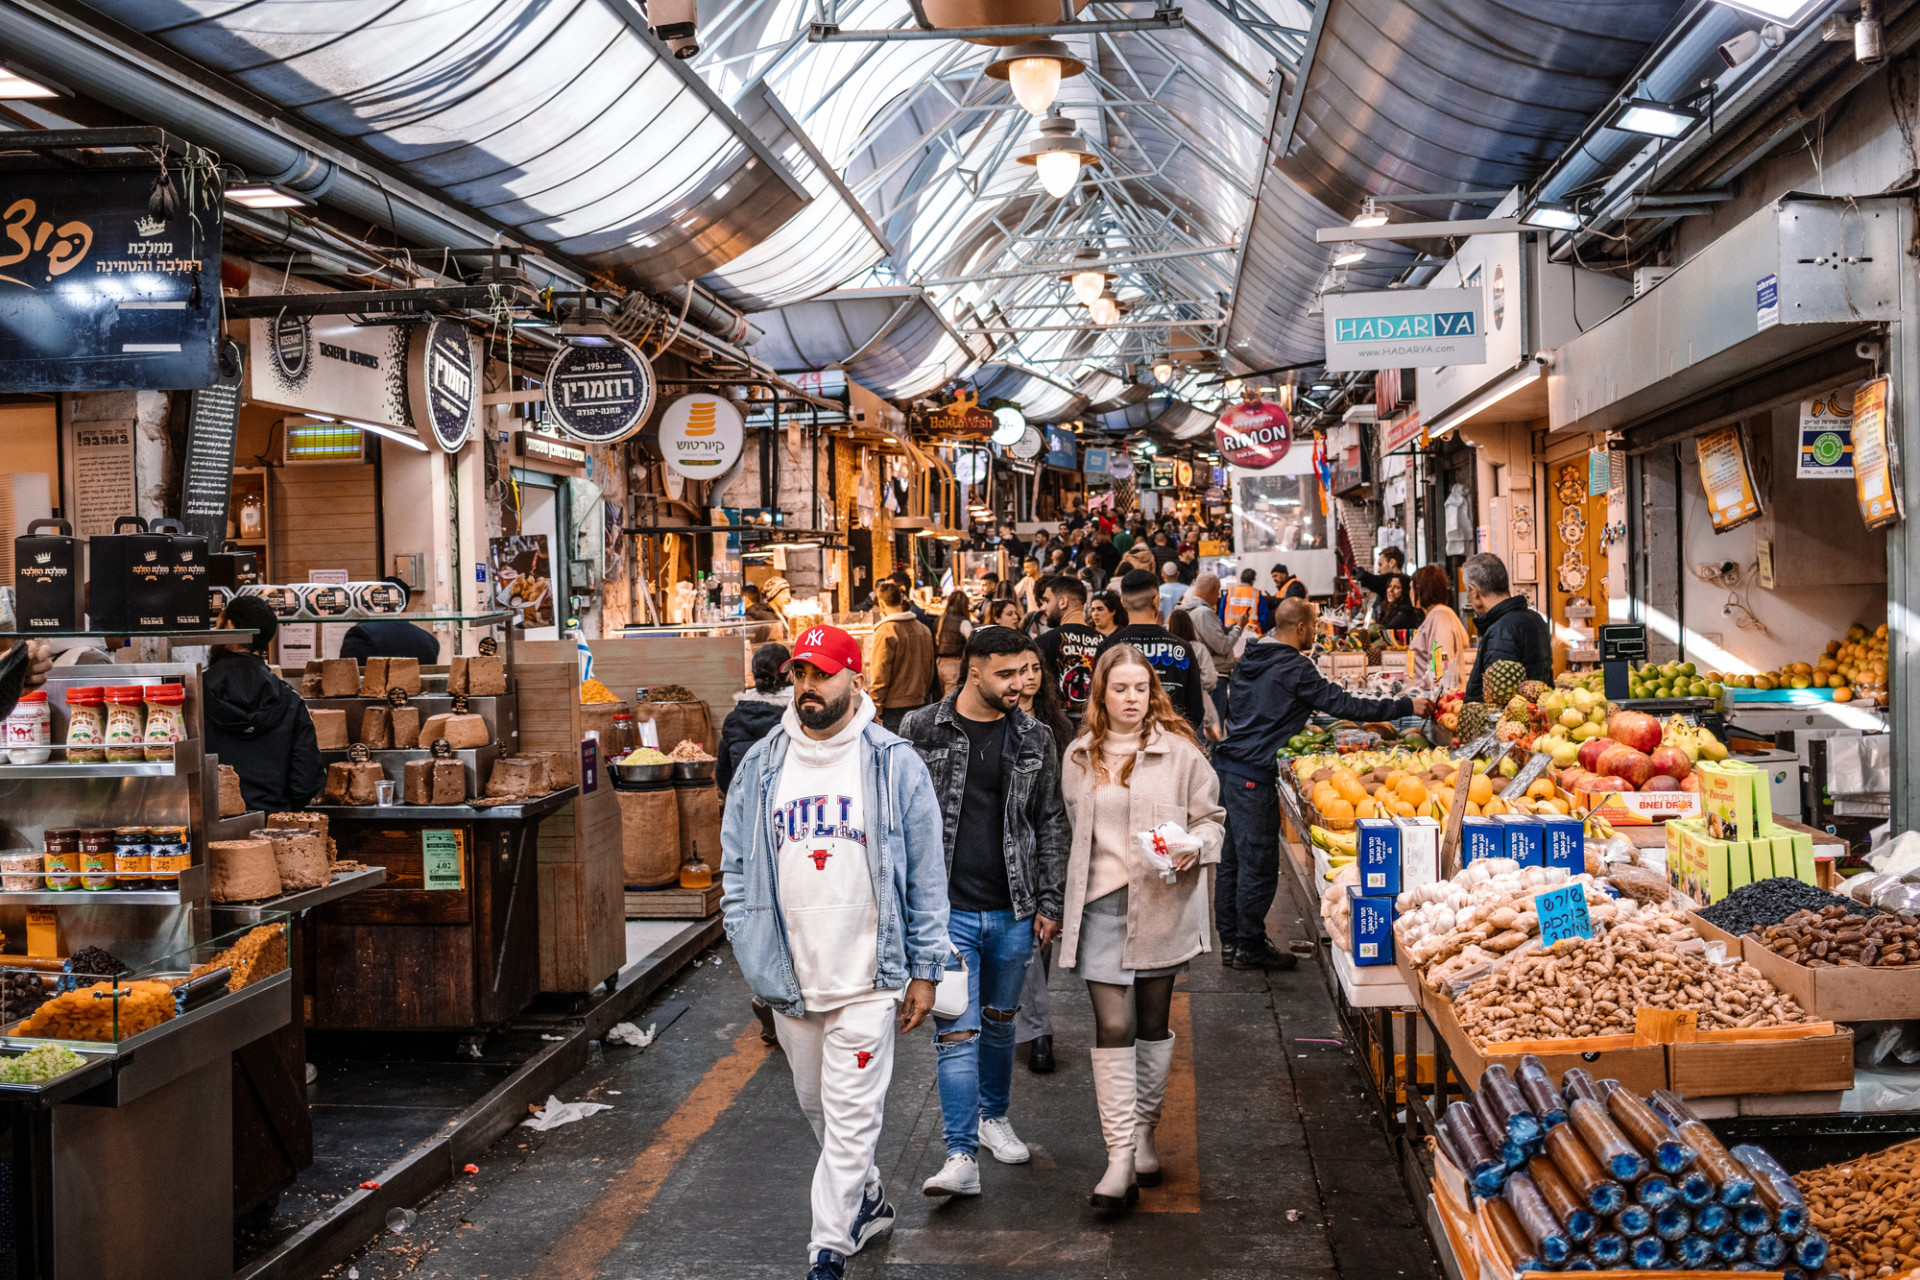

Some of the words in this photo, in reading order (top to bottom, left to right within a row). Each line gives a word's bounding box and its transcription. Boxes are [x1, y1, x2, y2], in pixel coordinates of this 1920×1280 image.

[1358, 345, 1455, 357] www.HADARYA.com
[586, 362, 605, 370] 1953
[561, 378, 634, 407] רוזמרין
[77, 432, 130, 447] באהבה!
[1223, 424, 1287, 451] RIMON
[676, 440, 725, 454] קיורטוש
[1064, 632, 1081, 643] YOU
[1639, 801, 1663, 809] BNEI
[1543, 888, 1582, 912] שורש
[1543, 908, 1586, 935] כורכום
